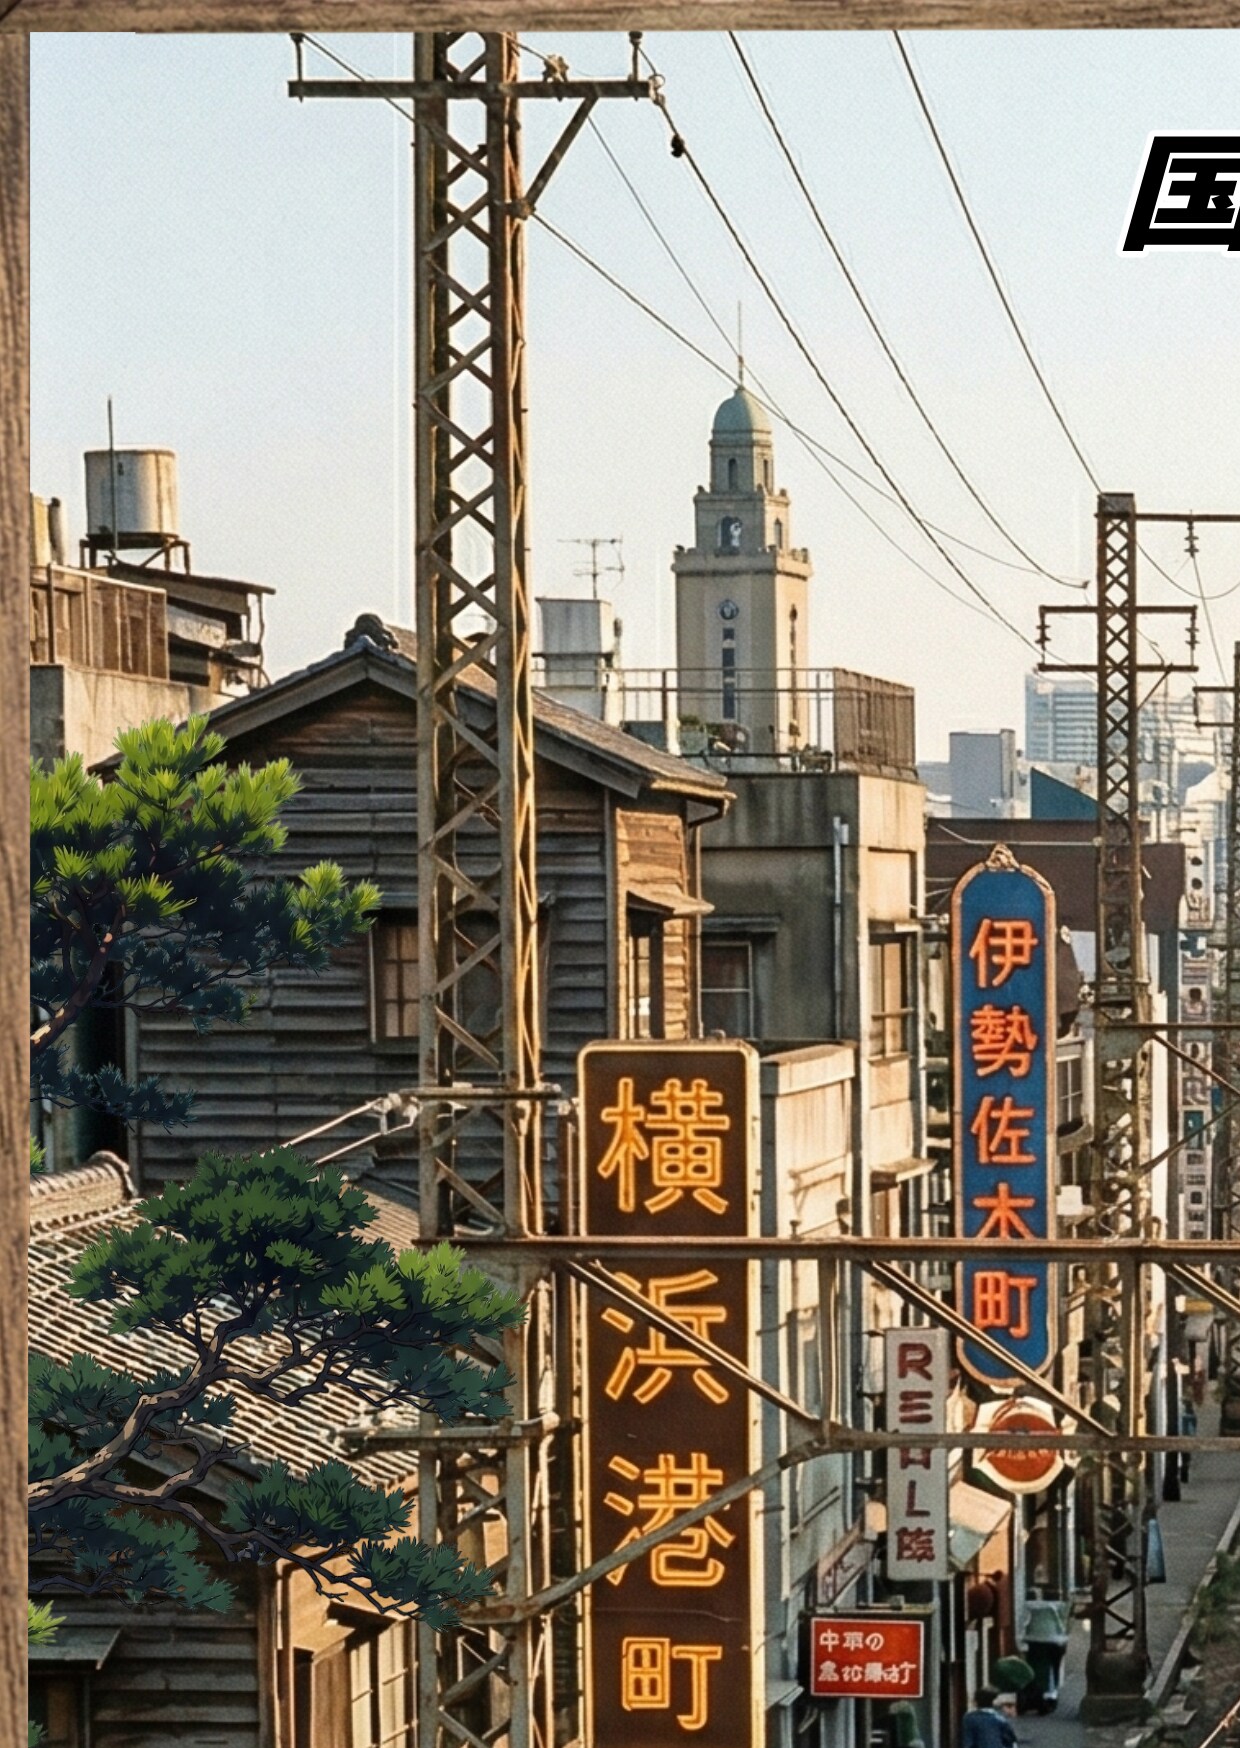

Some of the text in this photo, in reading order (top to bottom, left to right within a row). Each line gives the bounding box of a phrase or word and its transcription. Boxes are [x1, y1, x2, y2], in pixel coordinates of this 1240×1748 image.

[969, 917, 1039, 1339] 伊勢佐木町
[597, 1076, 736, 1732] 横浜港町
